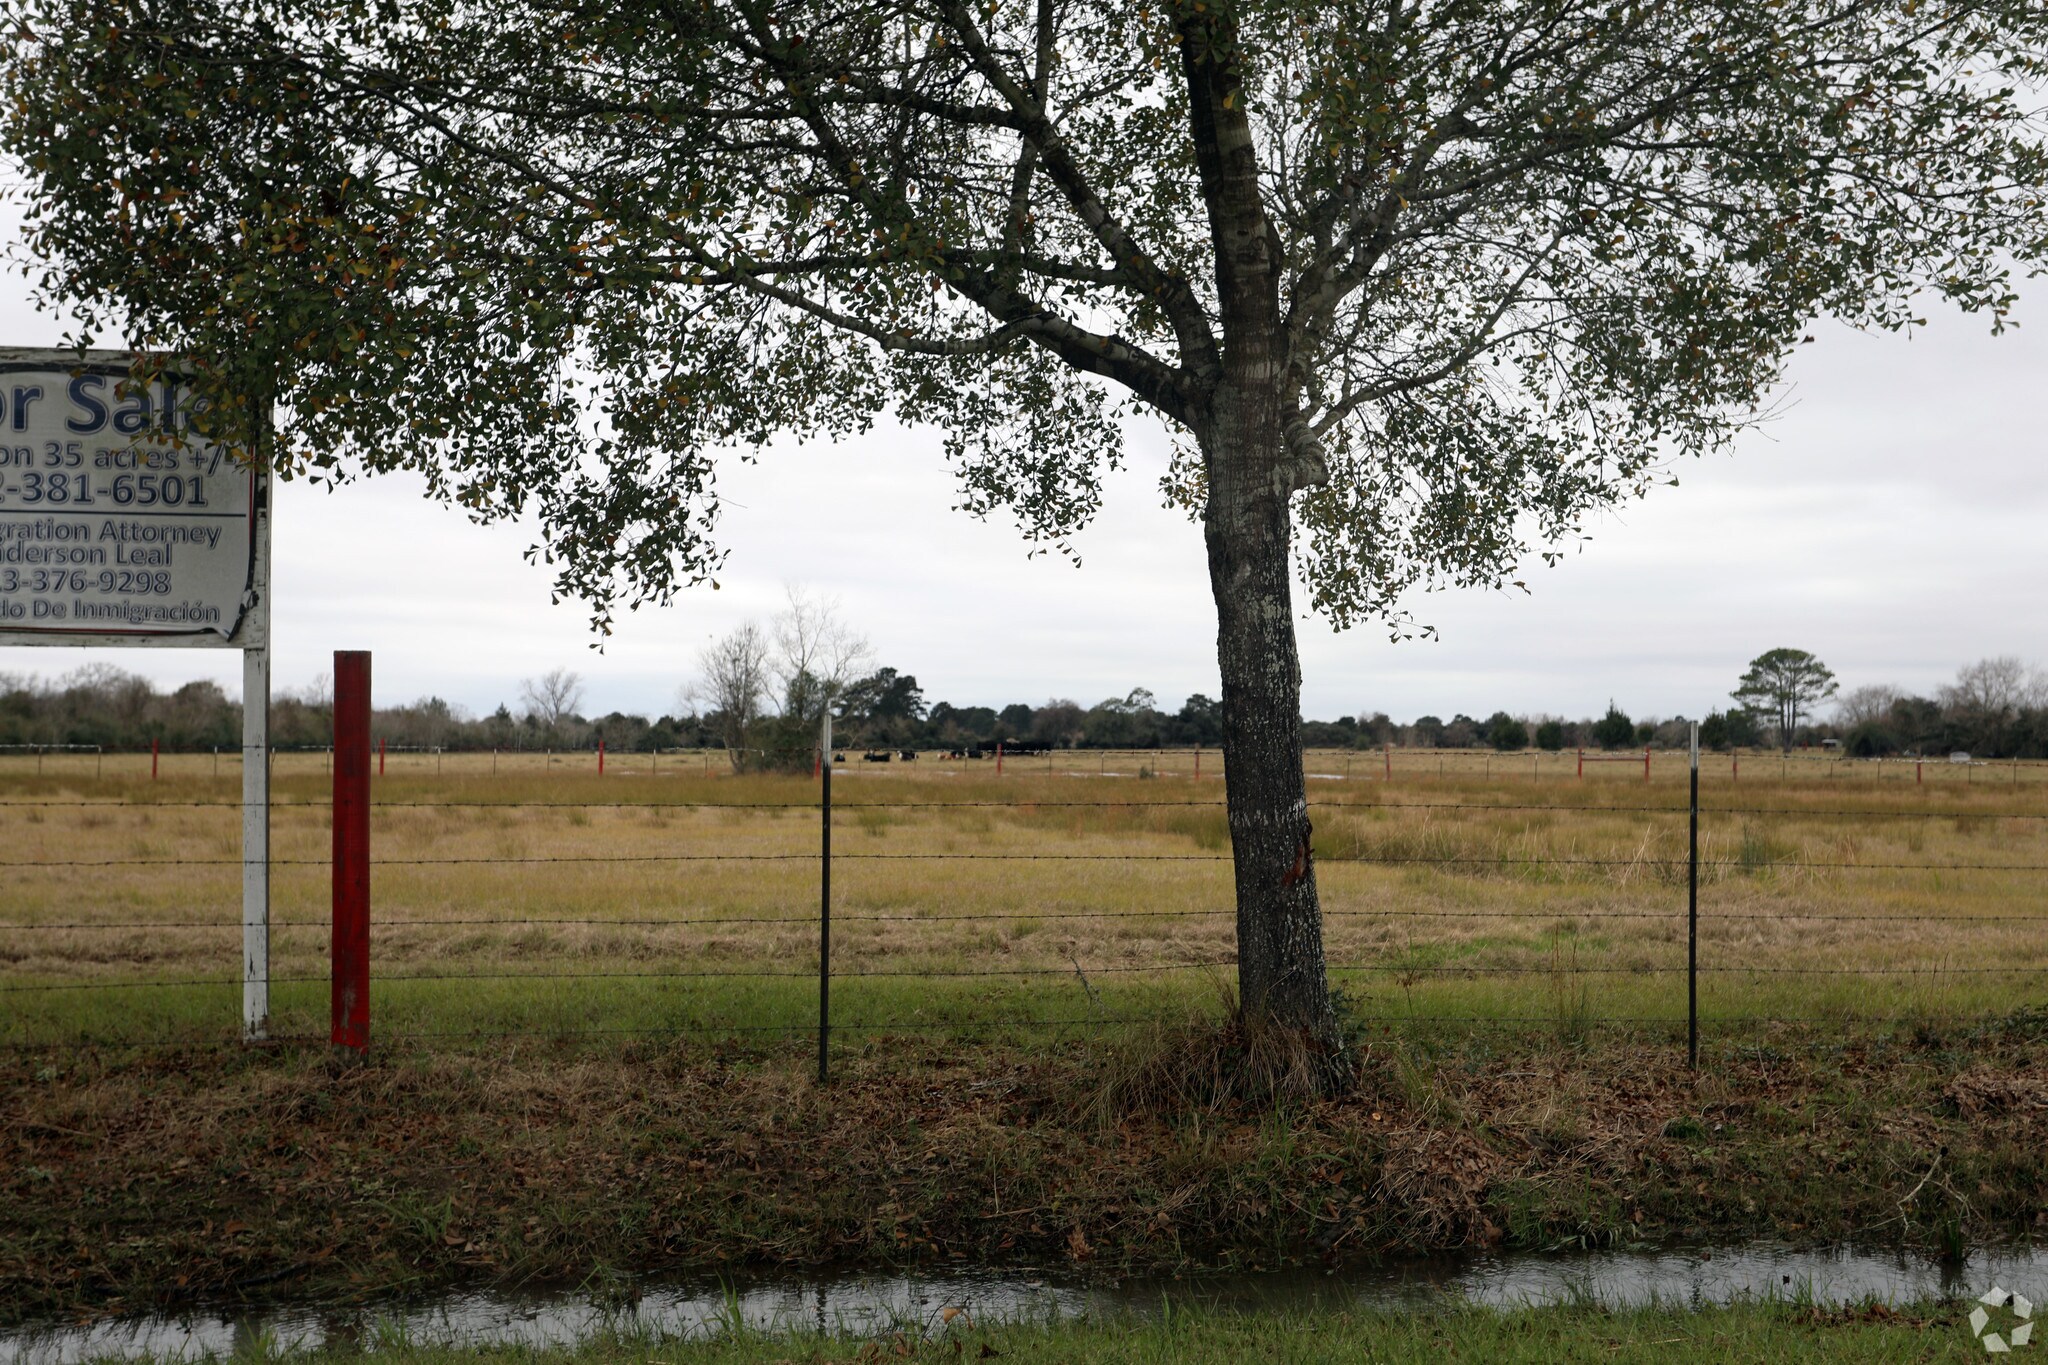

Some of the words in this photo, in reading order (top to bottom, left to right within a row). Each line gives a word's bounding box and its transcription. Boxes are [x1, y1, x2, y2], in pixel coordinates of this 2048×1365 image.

[0, 386, 43, 431] r
[45, 442, 83, 467] 35
[95, 448, 179, 469] acres
[0, 472, 206, 505] -381-6501
[99, 520, 222, 548] Attorney
[0, 540, 104, 564] derson
[116, 542, 173, 565] Leal
[0, 569, 170, 594] 3-376-9298
[33, 599, 67, 618] De
[74, 599, 219, 623] Inmigración
